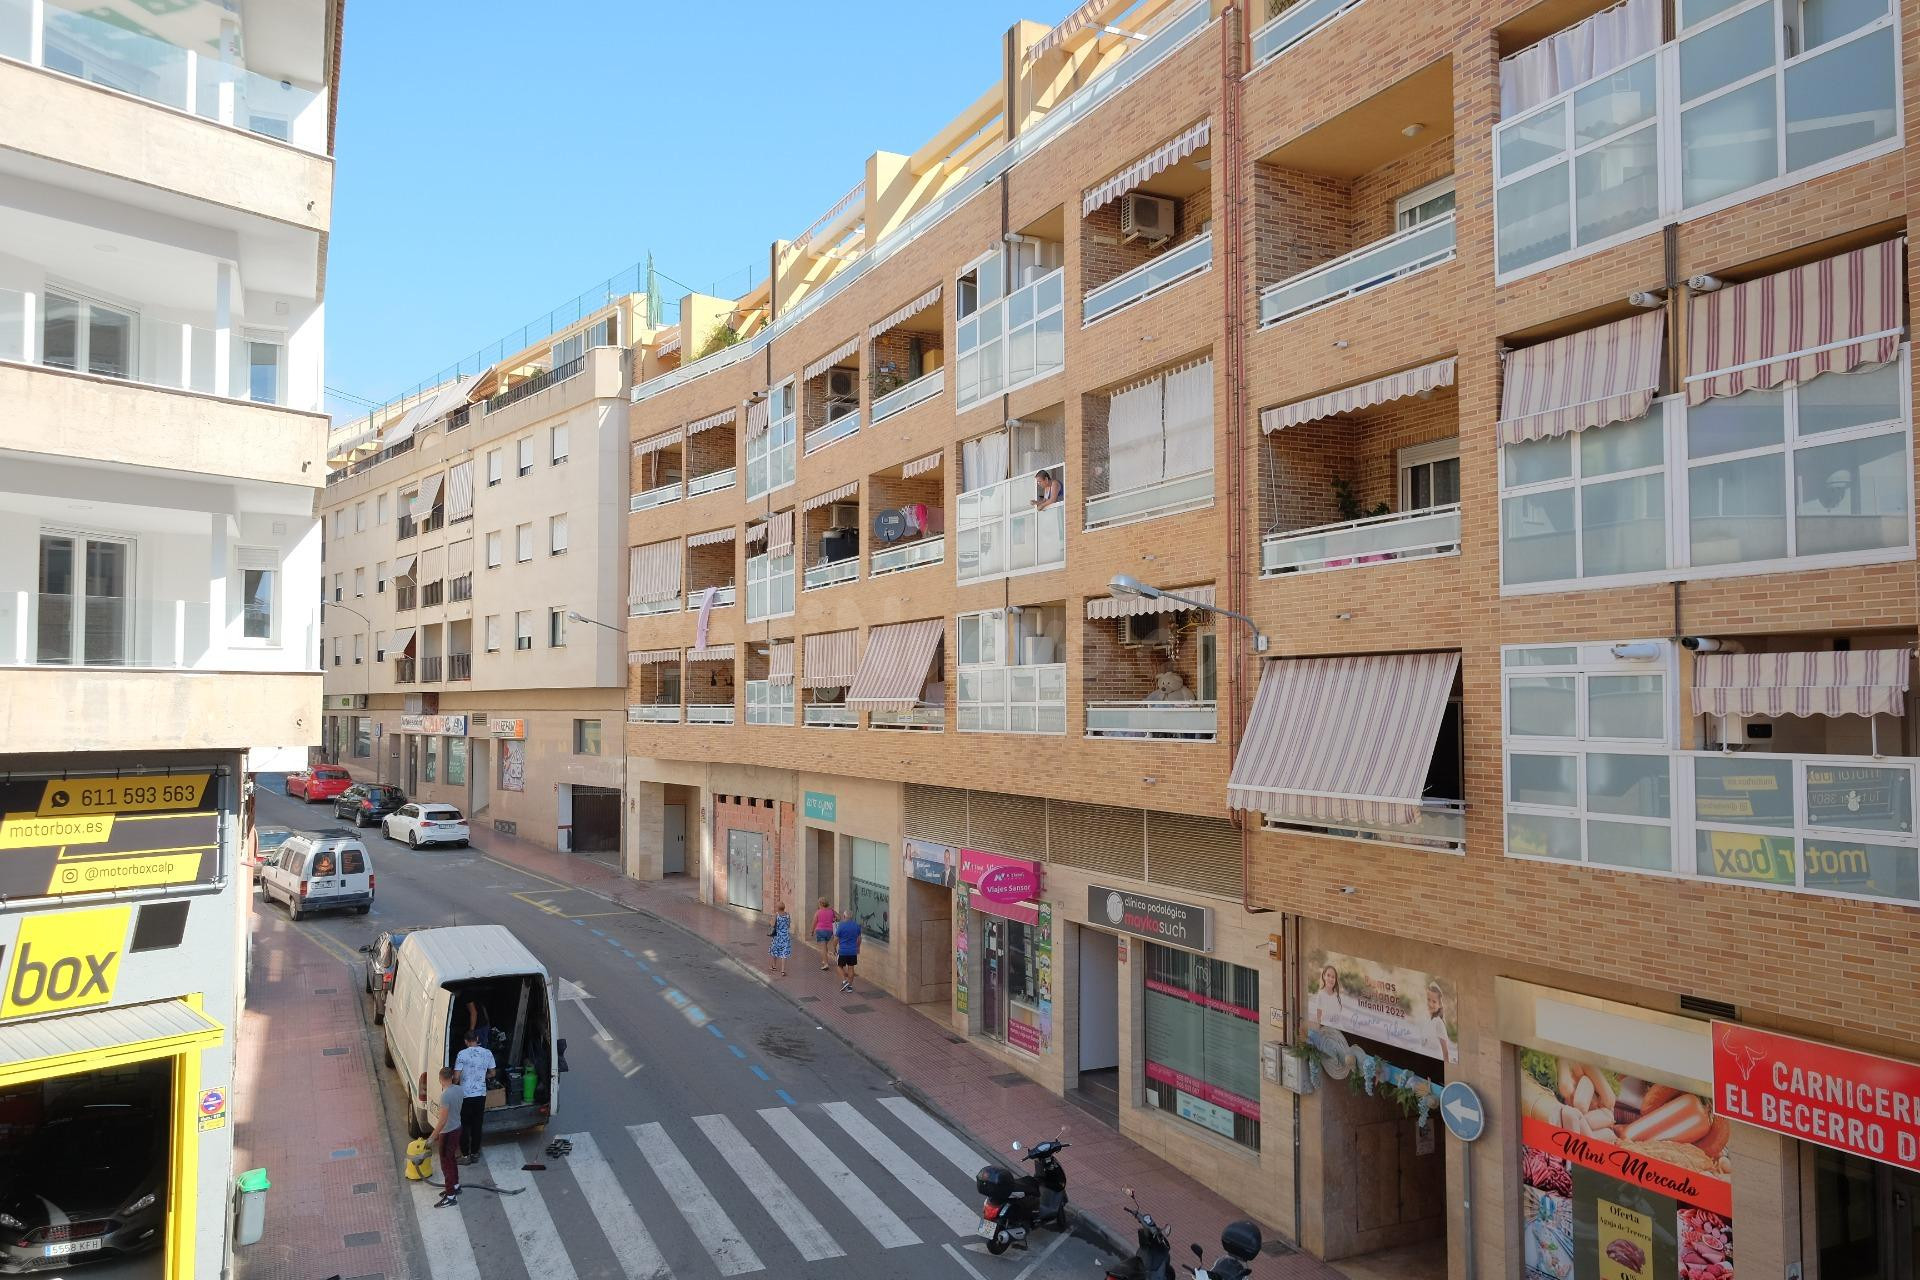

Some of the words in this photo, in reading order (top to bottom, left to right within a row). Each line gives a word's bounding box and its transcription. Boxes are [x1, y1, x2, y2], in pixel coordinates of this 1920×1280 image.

[81, 788, 117, 807] 611
[123, 786, 157, 805] 593
[162, 784, 196, 803] 563
[9, 820, 104, 838] motorbox.es
[84, 862, 175, 882] @motorboxcalp
[1124, 896, 1146, 909] clínica
[1147, 903, 1187, 919] podológica
[11, 941, 118, 1008] box
[1385, 1005, 1406, 1018] 2022
[1725, 1083, 1754, 1118] EL
[1761, 1092, 1885, 1154] BECERRO
[1551, 1131, 1606, 1166] Mini
[1608, 1150, 1700, 1197] Mercado
[1610, 1205, 1640, 1225] Oferta
[79, 1241, 98, 1251] KFH
